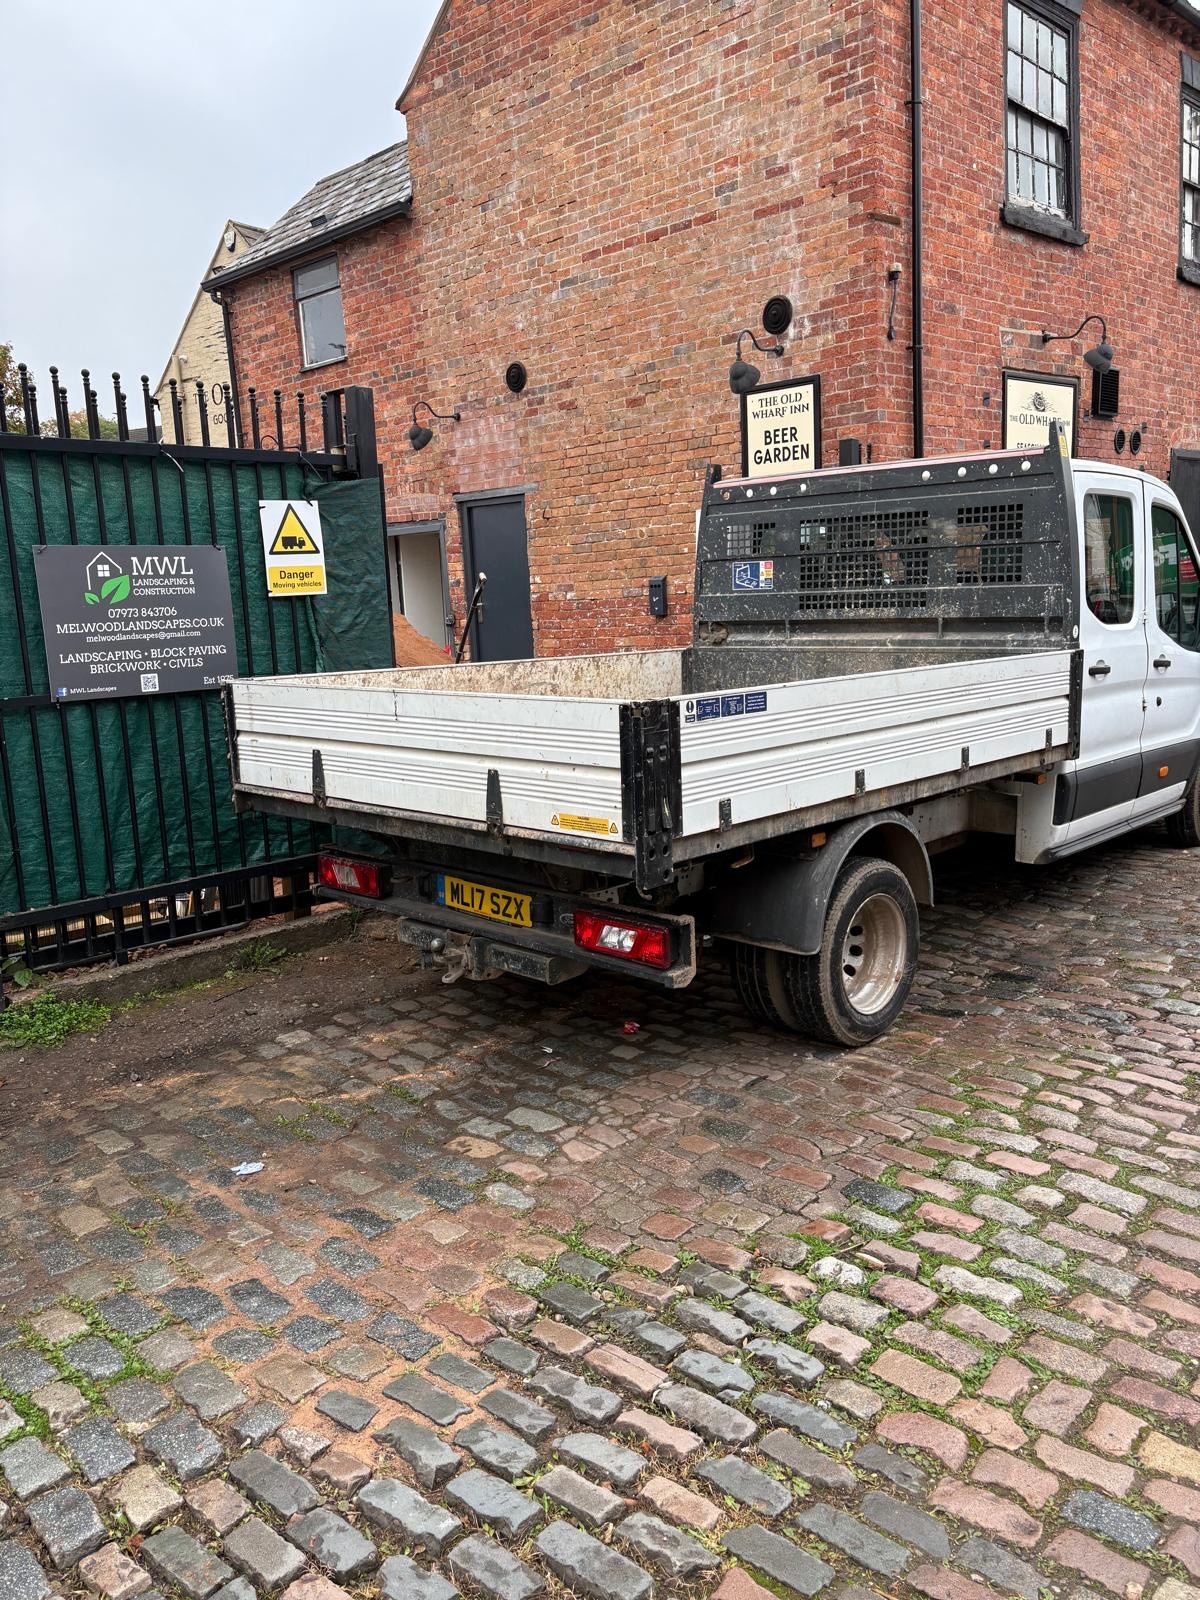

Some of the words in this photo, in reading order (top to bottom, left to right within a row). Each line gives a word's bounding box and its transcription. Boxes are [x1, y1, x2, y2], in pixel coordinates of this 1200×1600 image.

[758, 396, 779, 408] THE
[780, 392, 803, 404] OLD
[752, 406, 788, 420] WHARF
[790, 403, 809, 415] INN
[1019, 413, 1035, 425] OLD
[764, 426, 798, 446] BEER
[754, 443, 809, 465] GARDEN
[131, 556, 194, 576] MWL
[132, 577, 188, 587] LANDSCAPING
[279, 570, 314, 581] Danger
[133, 586, 196, 596] CONSTRUCTION
[108, 608, 139, 619] 07973
[141, 606, 178, 618] 843706
[56, 617, 225, 635] MELWOODLANDSCAPES.CO.UK
[86, 629, 201, 643] melwoodlandscapes@gmail.com
[59, 650, 142, 664] LANDSCAPING
[150, 647, 187, 659] BLOCK
[188, 645, 227, 656] PAVING
[90, 660, 162, 674] BRICKWORK
[168, 657, 204, 669] CIVILS
[203, 676, 216, 685] Est
[450, 881, 486, 911] ML17
[490, 892, 524, 921] SZX
